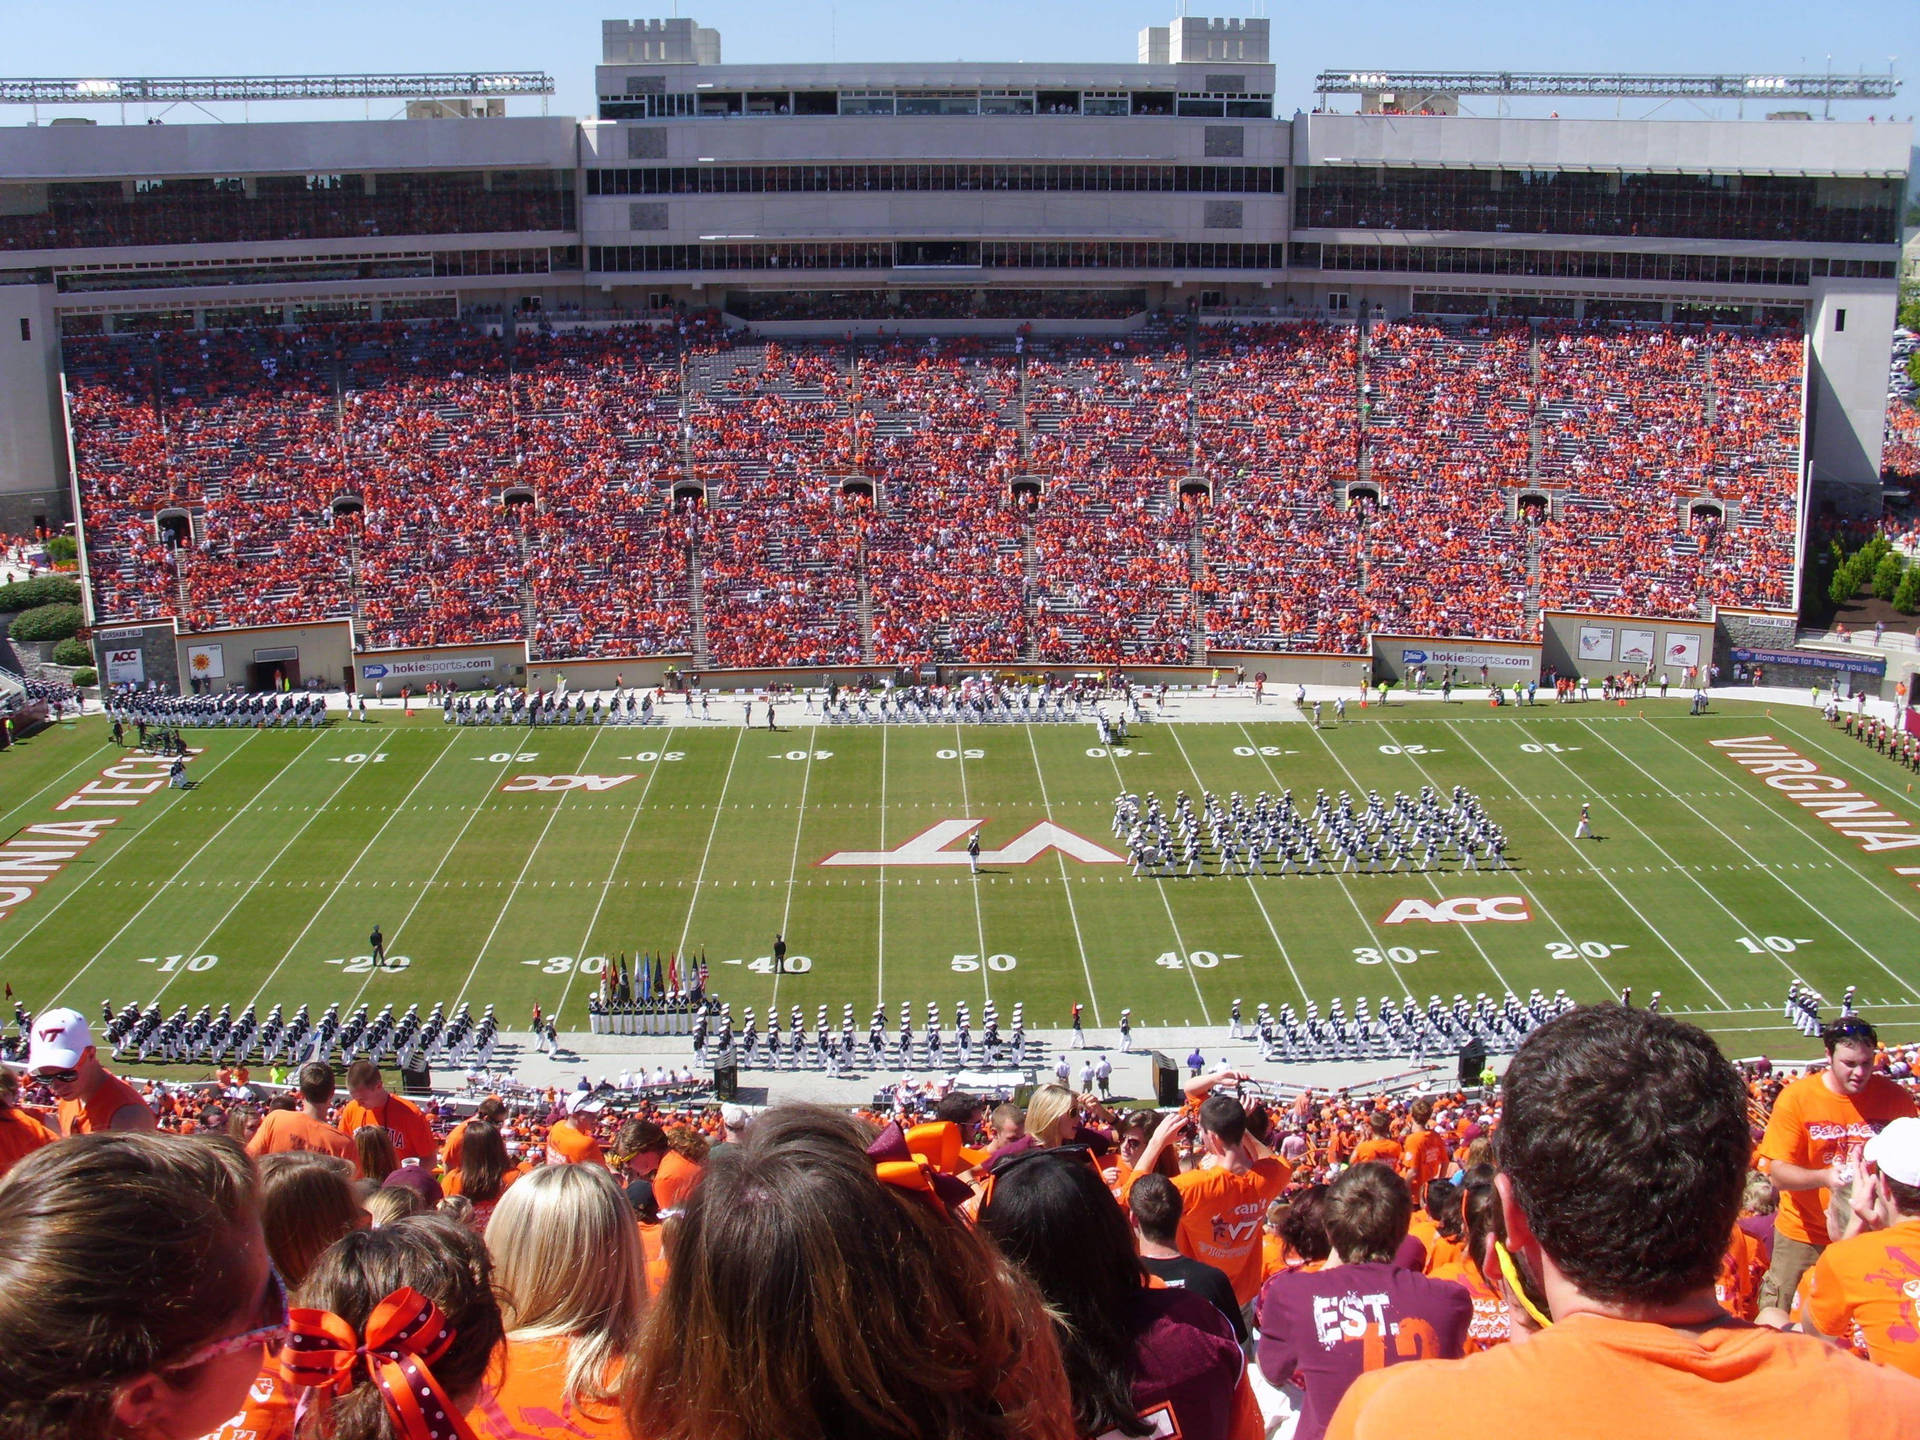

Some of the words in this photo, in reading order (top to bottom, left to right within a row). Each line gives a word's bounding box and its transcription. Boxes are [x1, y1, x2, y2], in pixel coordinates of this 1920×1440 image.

[1749, 617, 1776, 626] WORSHAM
[1776, 619, 1794, 627] FIELD
[127, 629, 142, 637] FIELD
[112, 651, 137, 662] ACC
[1432, 652, 1530, 666] hokiesports.com
[1754, 654, 1776, 663] More
[1777, 656, 1800, 665] value
[1801, 657, 1812, 666] for
[1813, 658, 1826, 668] the
[1828, 661, 1845, 671] way
[1846, 663, 1862, 673] you
[1862, 664, 1880, 674] live.
[393, 659, 491, 674] hokiesports.com
[55, 748, 205, 811] TECH
[502, 775, 637, 791] ACC
[1707, 735, 1920, 852] VIRGINIA
[1383, 896, 1529, 924] ACC
[1544, 941, 1612, 960] 20
[1734, 936, 1797, 954] 10
[157, 955, 219, 972] 10
[342, 955, 412, 974] 20
[747, 955, 814, 974] 40
[950, 953, 1017, 972] 50
[1155, 950, 1219, 970] 40
[1352, 946, 1418, 965] 30
[541, 956, 610, 974] 30
[38, 1027, 66, 1043] VT
[1234, 1198, 1266, 1216] can't
[1313, 1290, 1401, 1351] EST.
